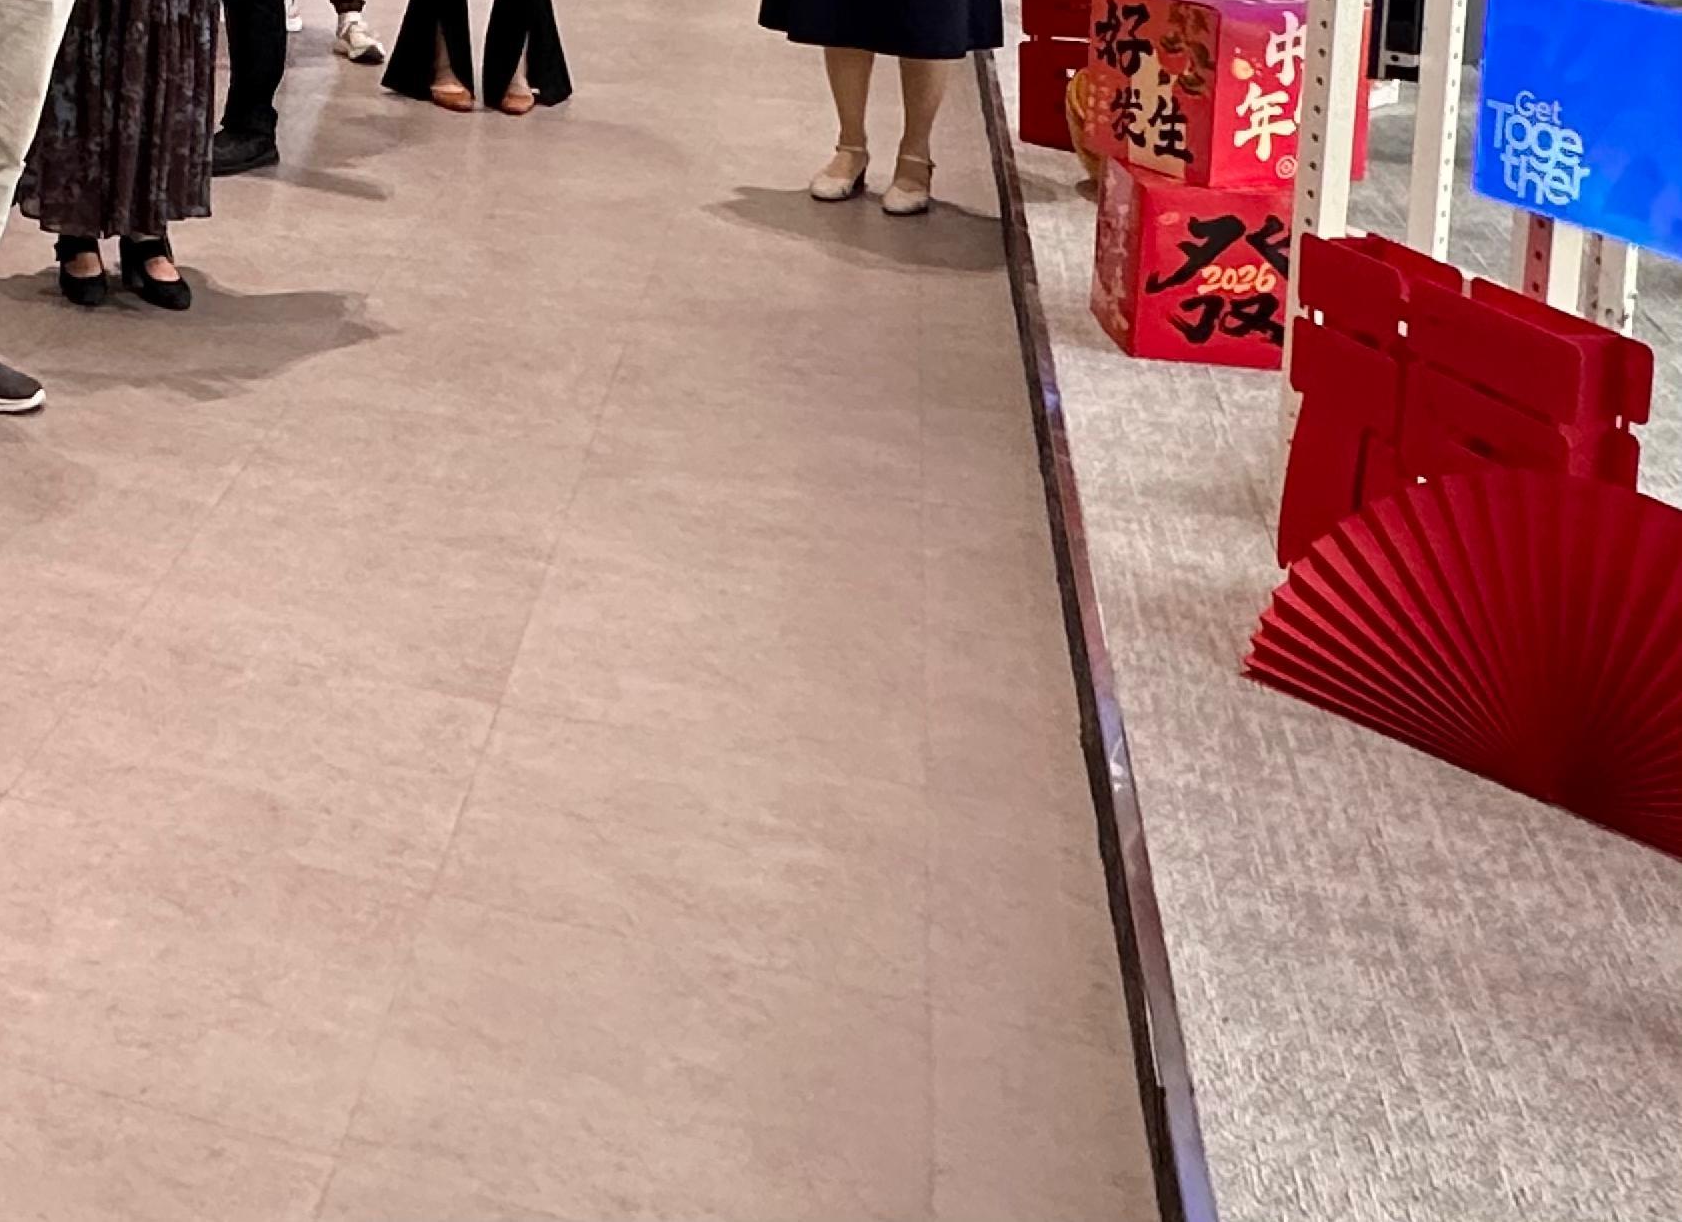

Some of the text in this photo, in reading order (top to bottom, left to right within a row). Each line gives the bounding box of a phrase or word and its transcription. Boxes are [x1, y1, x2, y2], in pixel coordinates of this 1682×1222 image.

[1515, 90, 1563, 126] Get
[1500, 144, 1591, 206] ther
[1197, 262, 1277, 296] 2026
